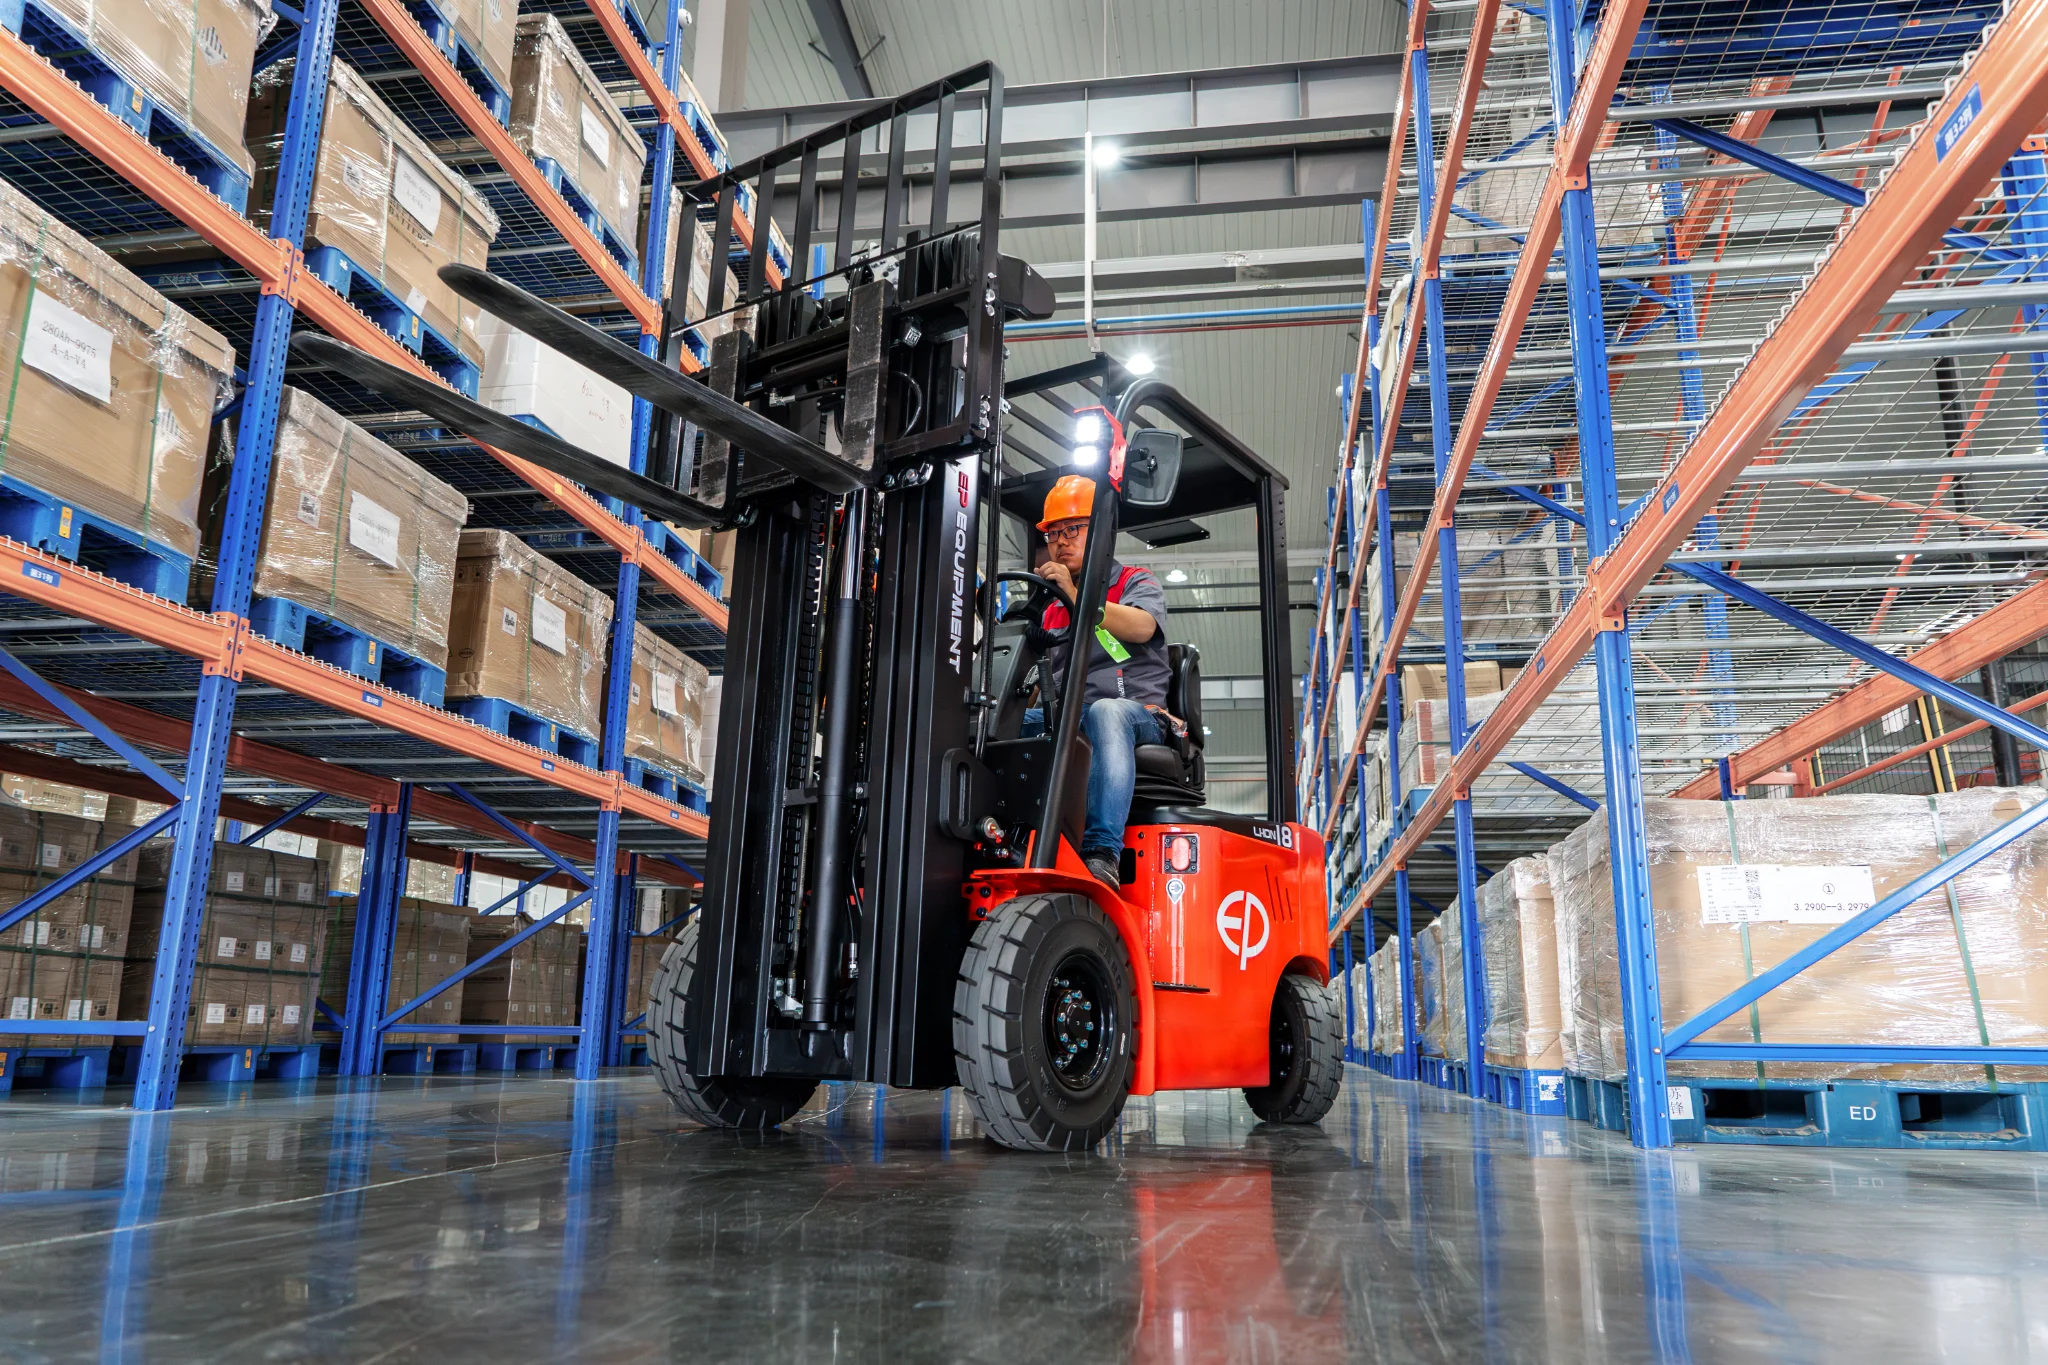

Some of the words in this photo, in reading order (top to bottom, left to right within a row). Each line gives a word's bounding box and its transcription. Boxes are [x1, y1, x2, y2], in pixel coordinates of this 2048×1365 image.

[41, 320, 97, 359] 280Ah-9975
[51, 344, 87, 369] A-A-V4
[957, 471, 969, 508] EP
[949, 510, 967, 675] EQUIPMENT
[1216, 890, 1270, 971] EP
[1849, 1106, 1877, 1121] ED
